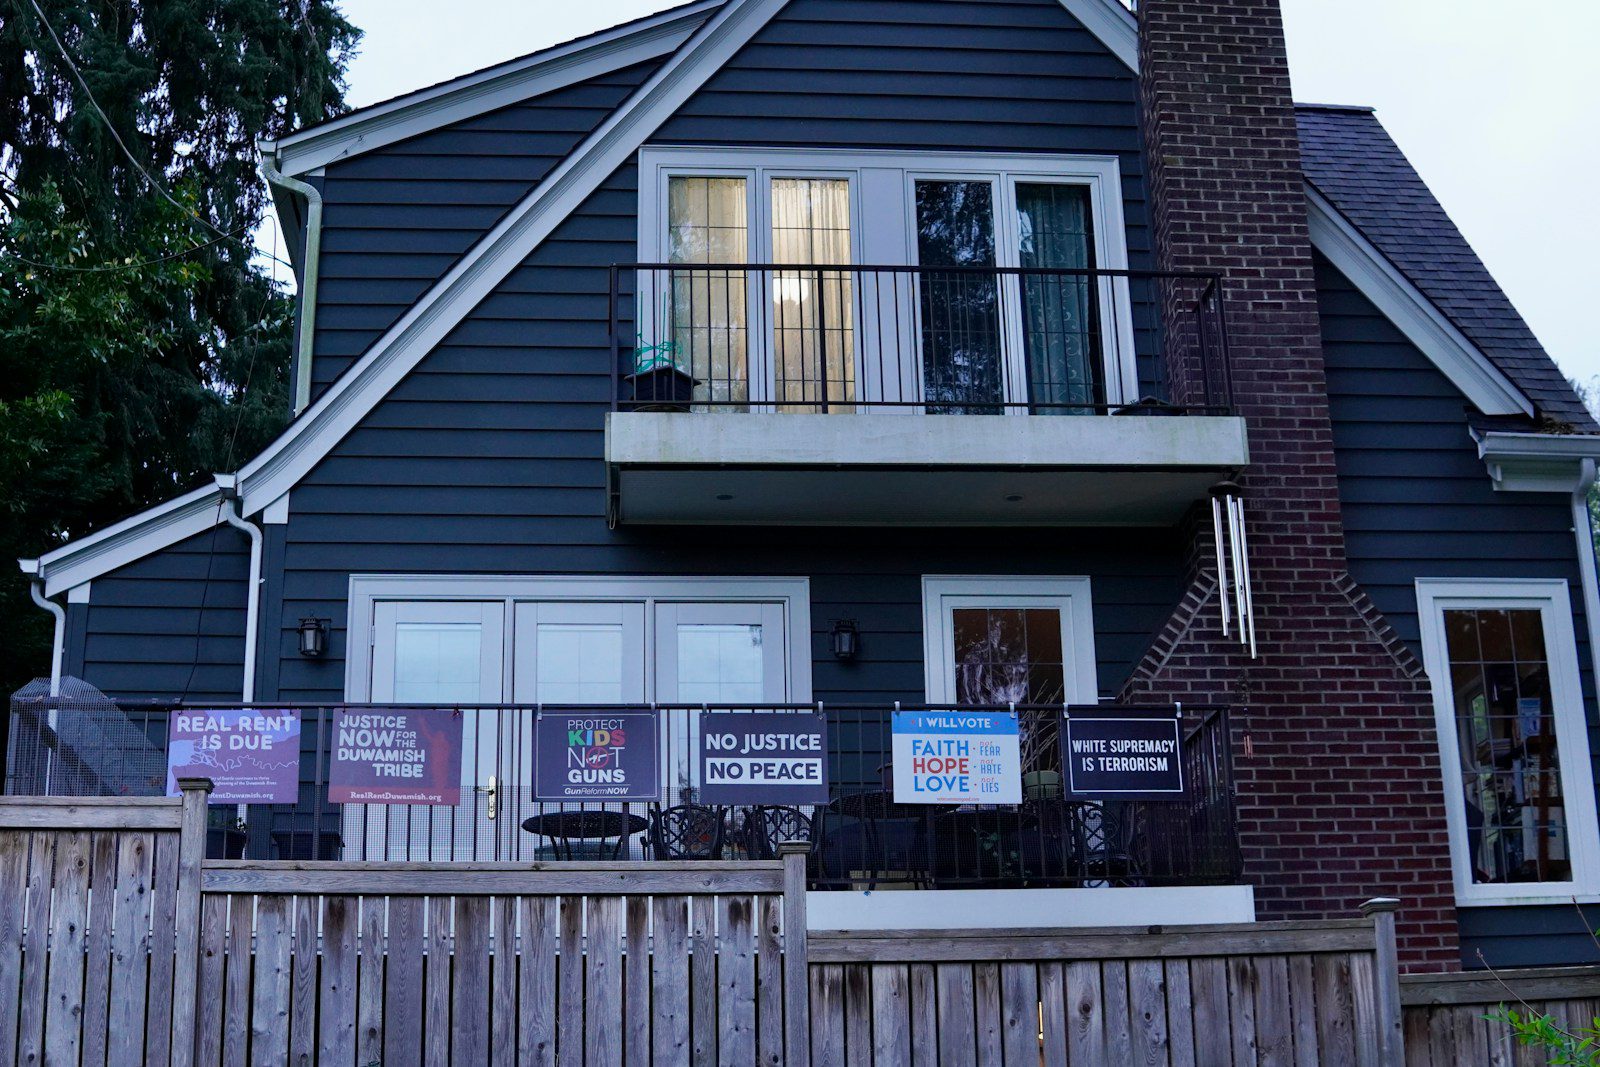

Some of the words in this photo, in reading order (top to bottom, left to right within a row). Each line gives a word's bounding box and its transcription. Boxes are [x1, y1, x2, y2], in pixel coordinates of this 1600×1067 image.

[177, 716, 232, 732] REAL
[238, 716, 296, 732] RENT
[339, 715, 407, 729] JUSTICE
[567, 719, 625, 730] PROTECT
[918, 717, 922, 728] I
[926, 717, 957, 728] WILL
[957, 717, 991, 729] VOTE
[201, 734, 222, 750] IS
[229, 734, 273, 750] DUE
[339, 729, 395, 747] NOW
[396, 731, 416, 739] FOR
[568, 729, 626, 747] KIDS
[395, 739, 416, 748] THE
[705, 733, 738, 750] NO
[740, 733, 822, 754] JUSTICE
[912, 739, 969, 756] FAITH
[980, 745, 1000, 756] FEAR
[1072, 740, 1107, 753] WHITE
[1109, 740, 1175, 753] SUPREMACY
[338, 748, 425, 762] DUWAMISH
[372, 763, 424, 778] TRIBE
[709, 762, 744, 779] NO
[749, 762, 818, 779] PEACE
[913, 757, 970, 774] HOPE
[981, 764, 1002, 775] HATE
[1082, 757, 1095, 772] IS
[1098, 757, 1168, 772] TERRORISM
[567, 769, 626, 783] GUNS
[914, 775, 970, 792] LOVE
[981, 782, 999, 793] LIES
[350, 792, 442, 802] RealRentDuwamish.org
[564, 787, 629, 795] GunReformNOW
